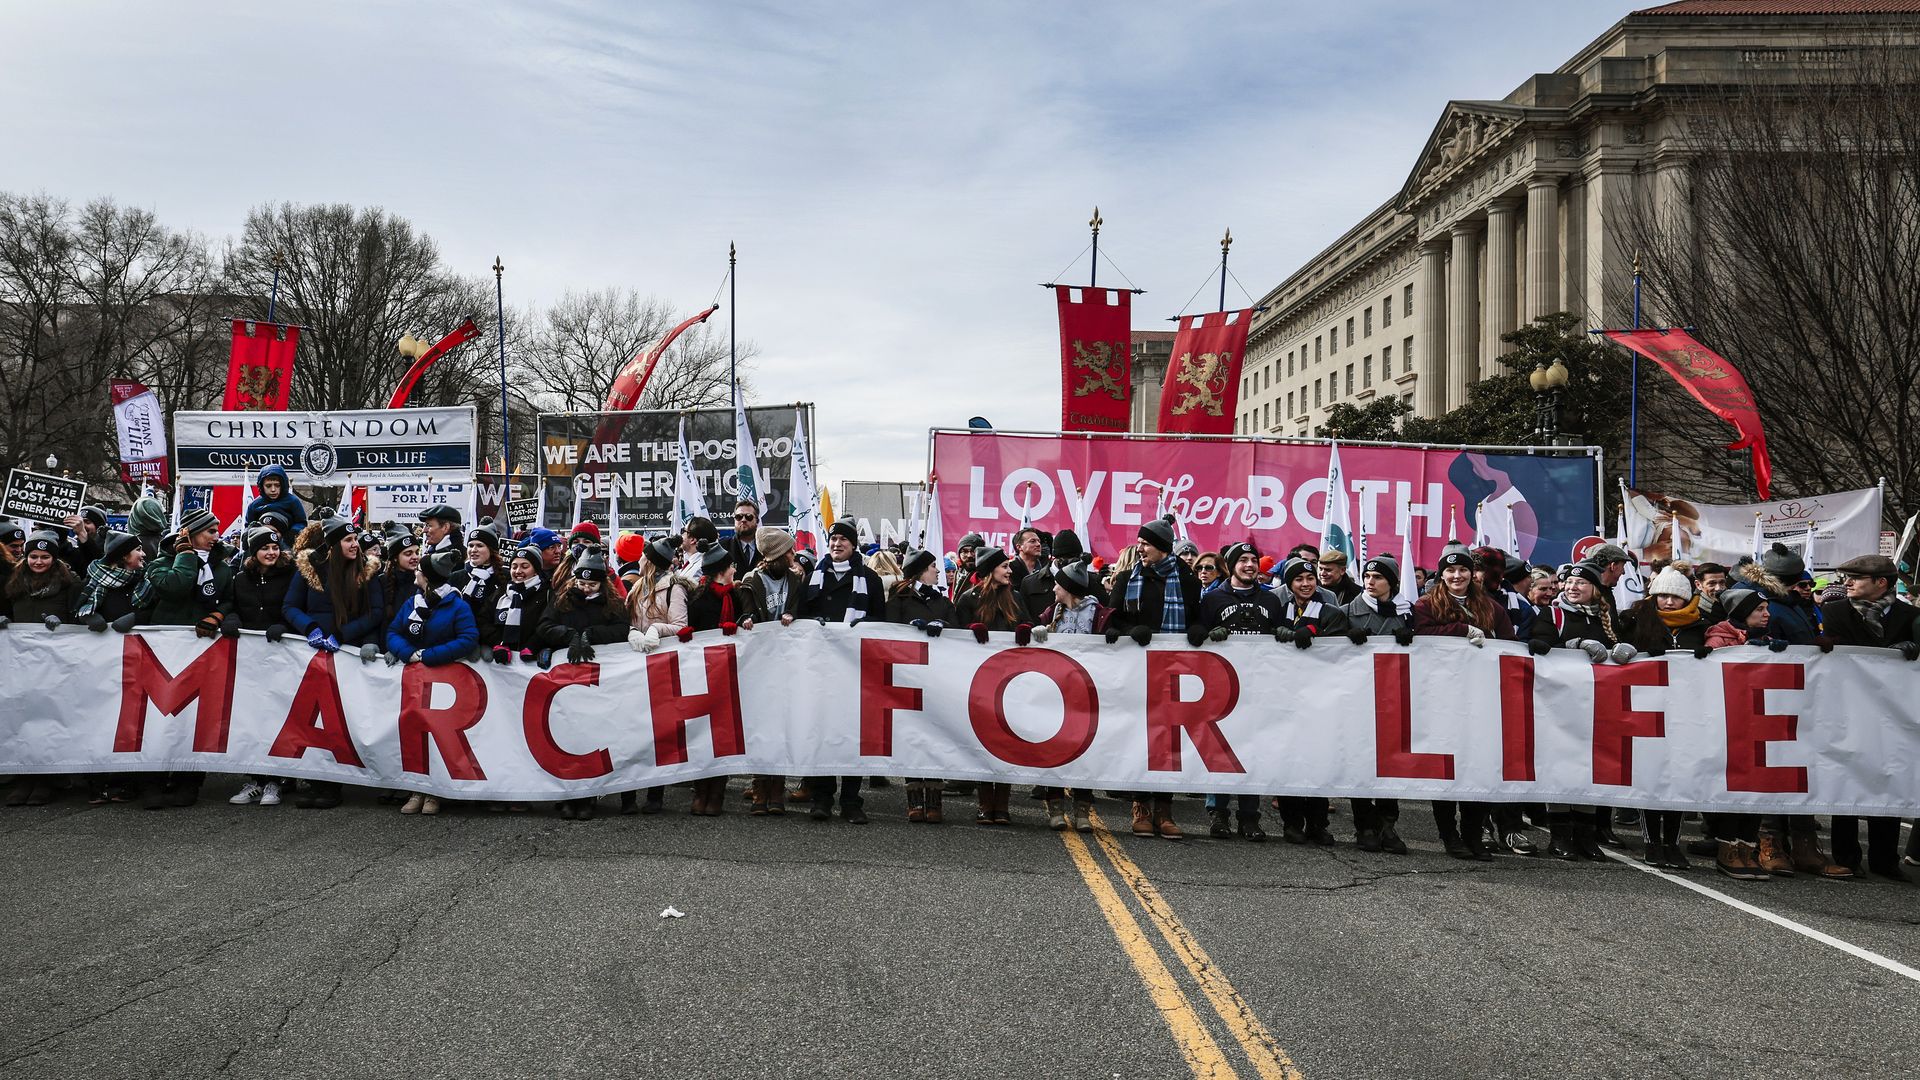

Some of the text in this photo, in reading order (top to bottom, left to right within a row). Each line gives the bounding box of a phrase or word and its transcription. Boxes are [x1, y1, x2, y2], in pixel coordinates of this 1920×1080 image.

[140, 412, 152, 446] TITANS
[207, 417, 438, 438] CHRISTENDOM
[128, 426, 144, 457] LIFE
[542, 445, 578, 464] WE
[584, 443, 630, 464] ARE
[637, 441, 680, 462] THE
[688, 436, 808, 460] POS-RO
[128, 462, 160, 473] TRINITY
[356, 451, 390, 464] FOR
[394, 449, 427, 464] LIFE
[15, 478, 78, 498] I AM THE
[477, 483, 522, 506] WE
[573, 468, 771, 498] GENERTION
[7, 500, 75, 518] GENERATION
[9, 487, 80, 510] POST-ROE
[392, 494, 446, 504] FOR LFE
[969, 466, 1143, 526] LOVE
[1135, 474, 1259, 526] them
[1247, 475, 1444, 538] BOTH
[508, 507, 537, 516] POST-RO
[111, 634, 1809, 793] MARCH FOR LIFE
